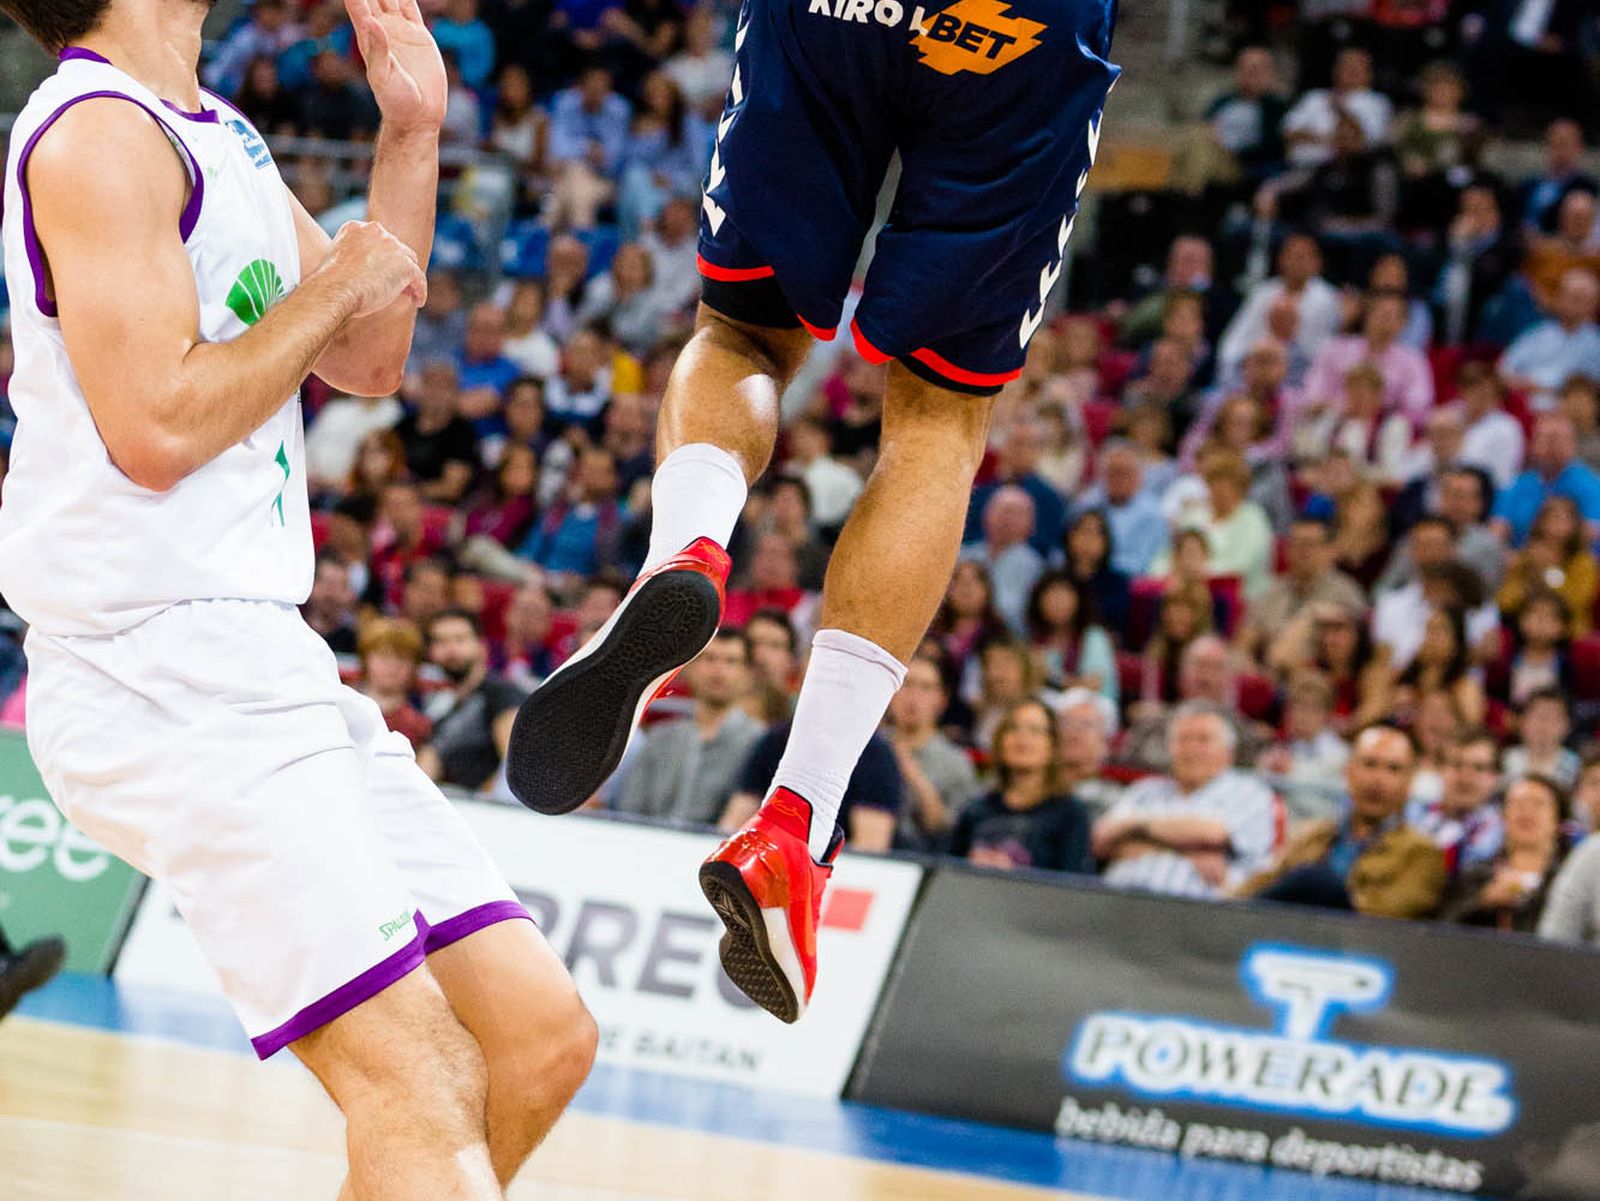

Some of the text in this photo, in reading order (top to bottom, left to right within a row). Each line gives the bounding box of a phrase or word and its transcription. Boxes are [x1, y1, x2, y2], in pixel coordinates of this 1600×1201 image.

[1066, 1012, 1518, 1134] POWERADE
[1055, 1096, 1486, 1192] bebida para deportistas
